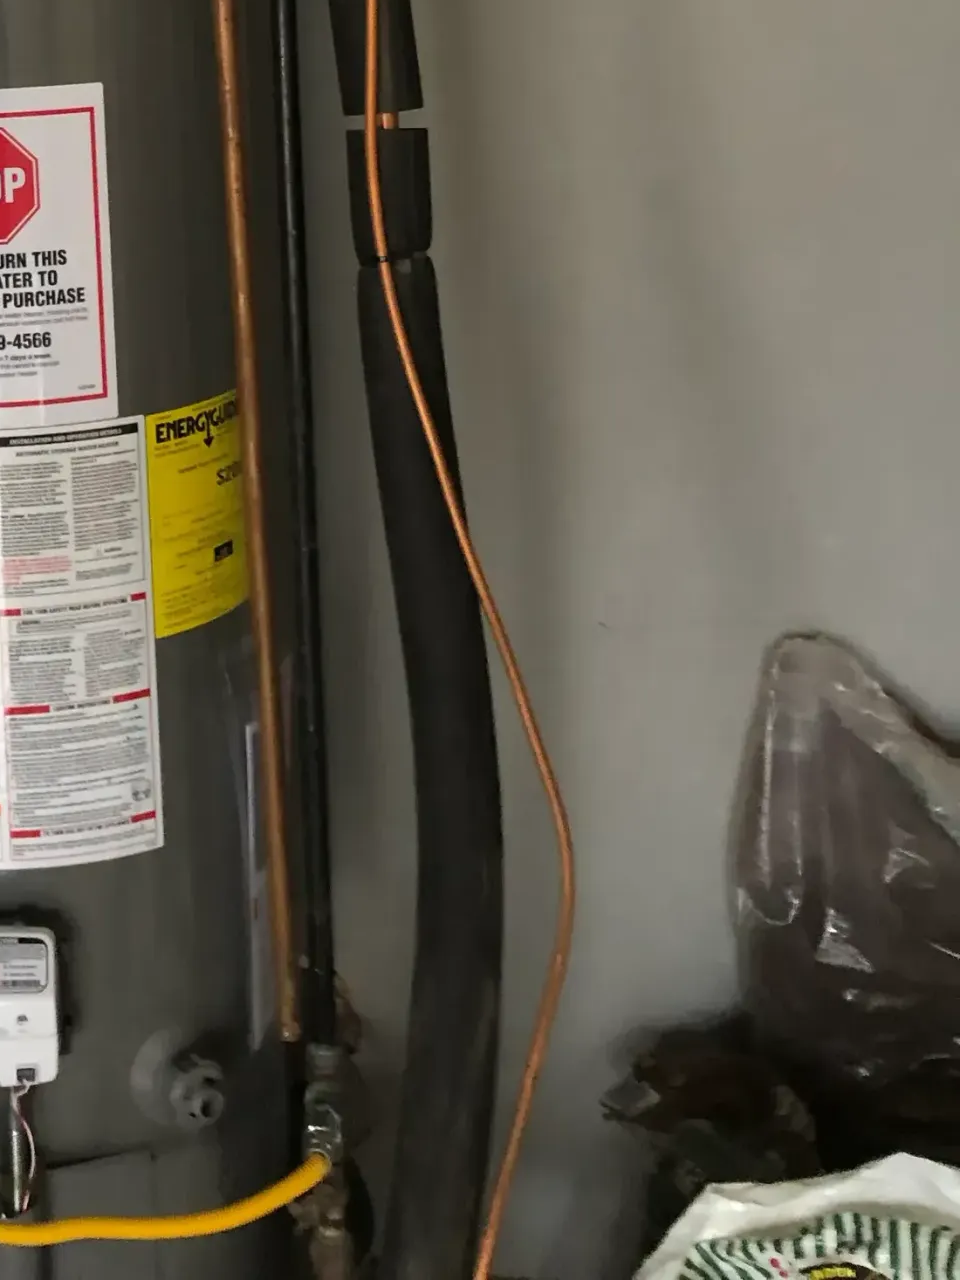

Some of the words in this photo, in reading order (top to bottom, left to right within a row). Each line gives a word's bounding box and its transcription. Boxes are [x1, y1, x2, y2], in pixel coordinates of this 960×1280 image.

[31, 249, 67, 266] THIS
[38, 270, 58, 286] TO
[2, 287, 86, 309] PURCHASE
